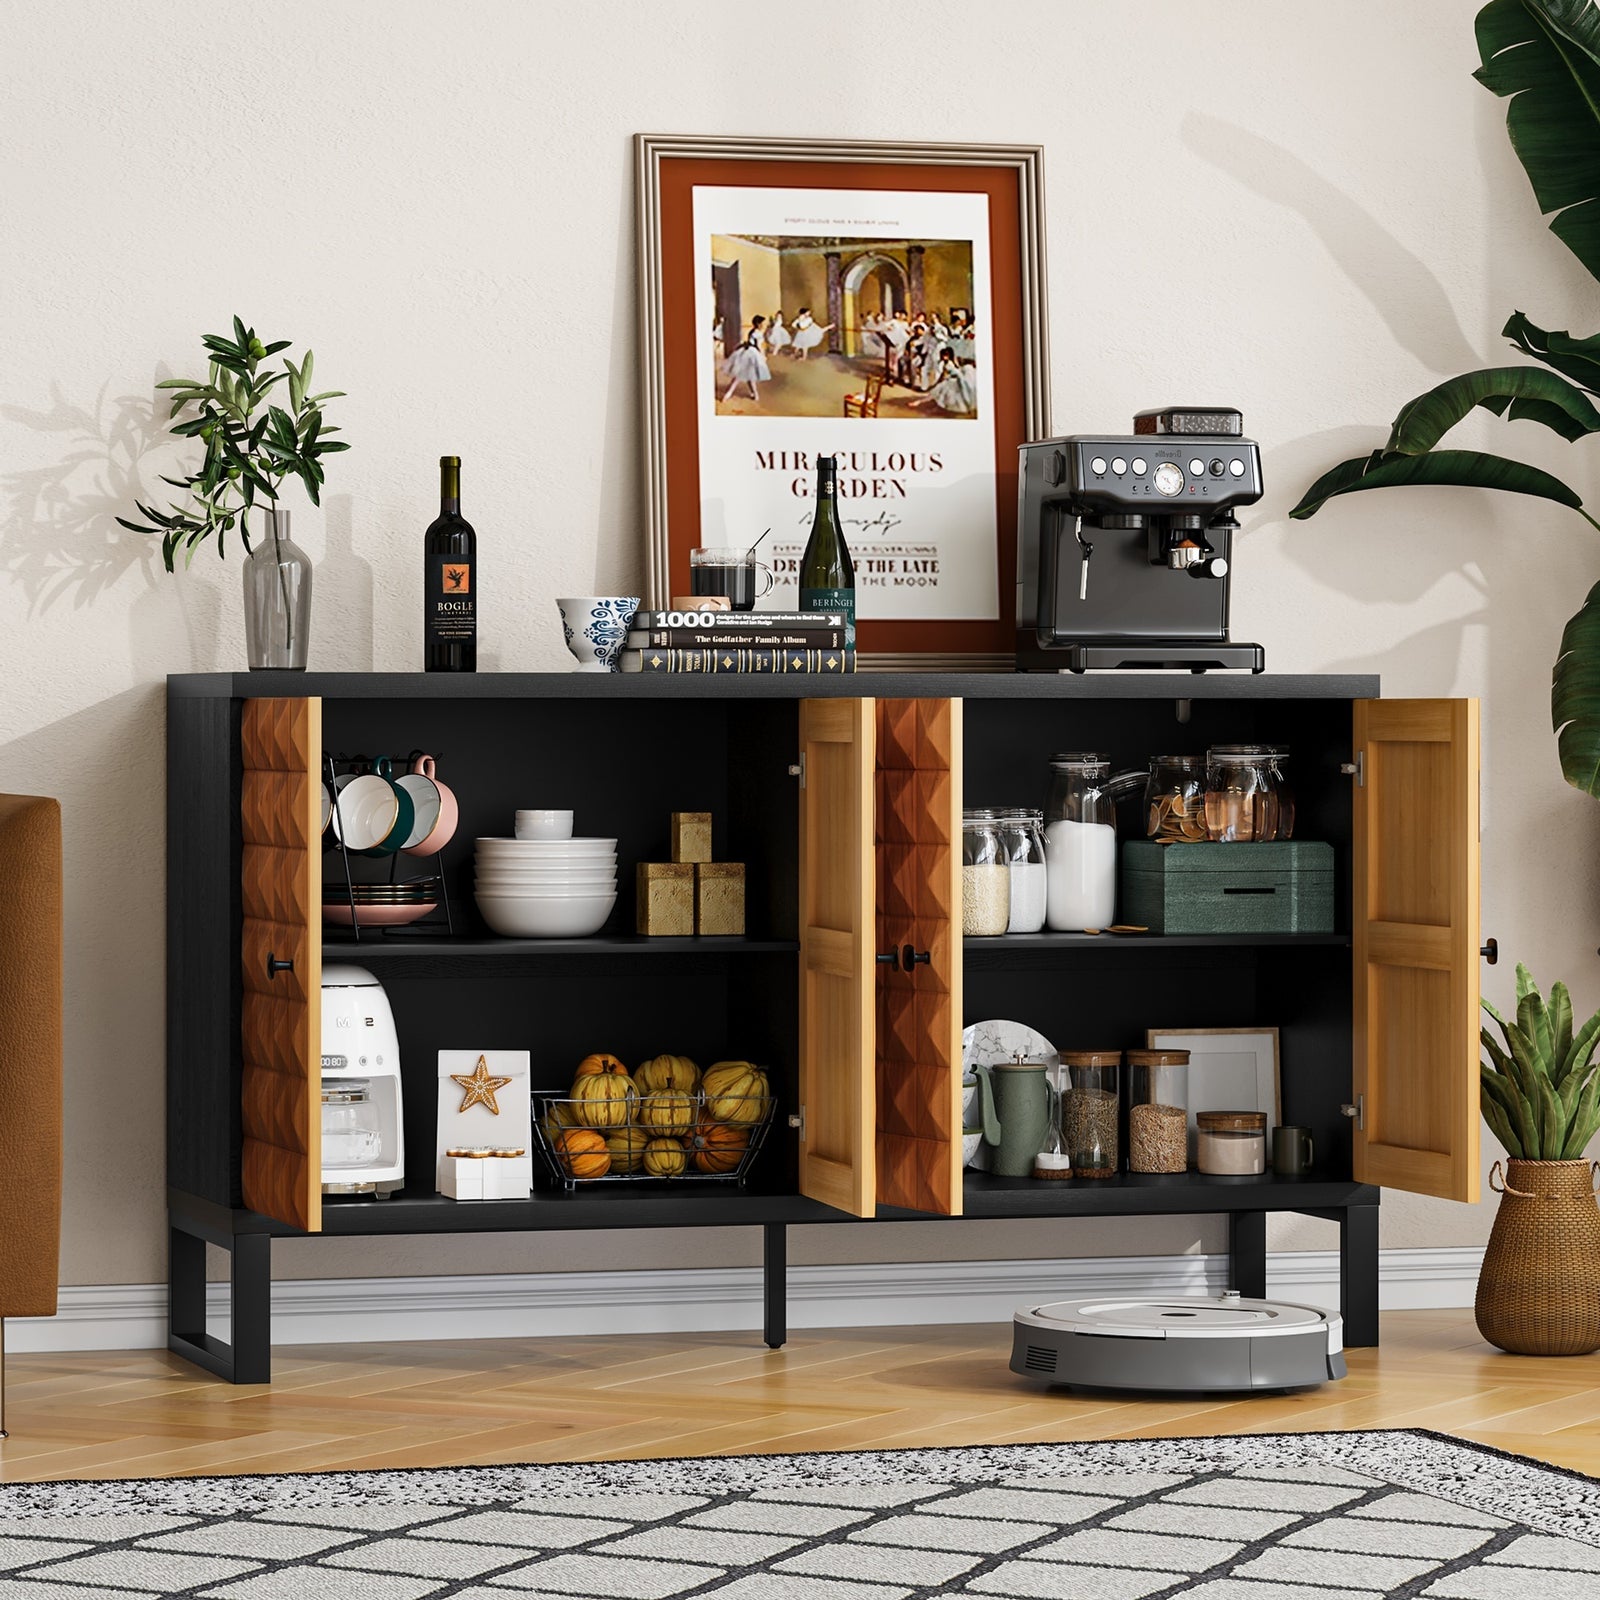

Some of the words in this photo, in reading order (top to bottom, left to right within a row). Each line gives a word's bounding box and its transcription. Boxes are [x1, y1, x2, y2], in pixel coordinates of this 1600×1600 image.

[755, 451, 944, 473] MIRCULOUS
[791, 478, 907, 499] GRDEN
[866, 560, 897, 574] THE
[902, 560, 940, 574] LATE
[893, 576, 938, 588] MOON
[437, 601, 474, 612] BOGLE
[656, 611, 716, 628] 1000
[694, 635, 711, 643] The
[712, 635, 753, 643] Godfather
[755, 635, 781, 645] Family
[782, 636, 807, 644] Album
